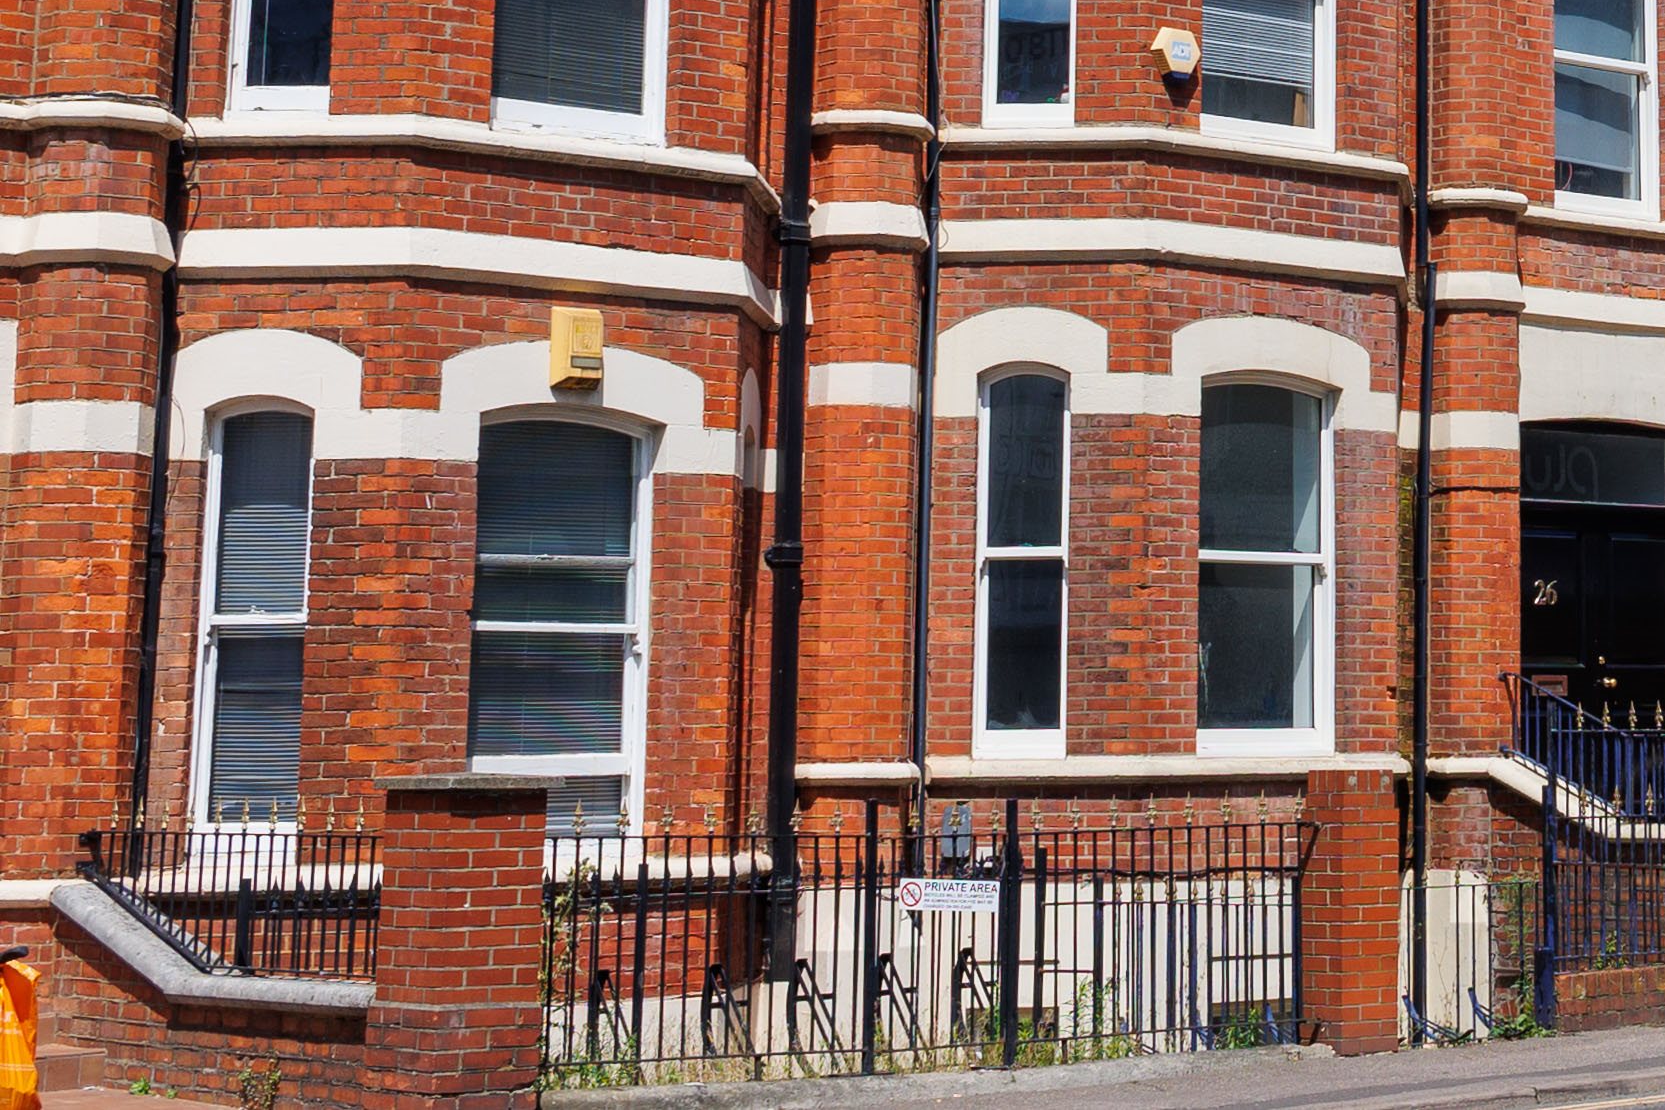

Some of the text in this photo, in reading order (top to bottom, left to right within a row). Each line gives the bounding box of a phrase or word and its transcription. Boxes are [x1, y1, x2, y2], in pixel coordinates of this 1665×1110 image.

[1171, 44, 1191, 58] ADT
[1534, 579, 1558, 606] 26
[924, 882, 998, 894] PRIVATE AREA
